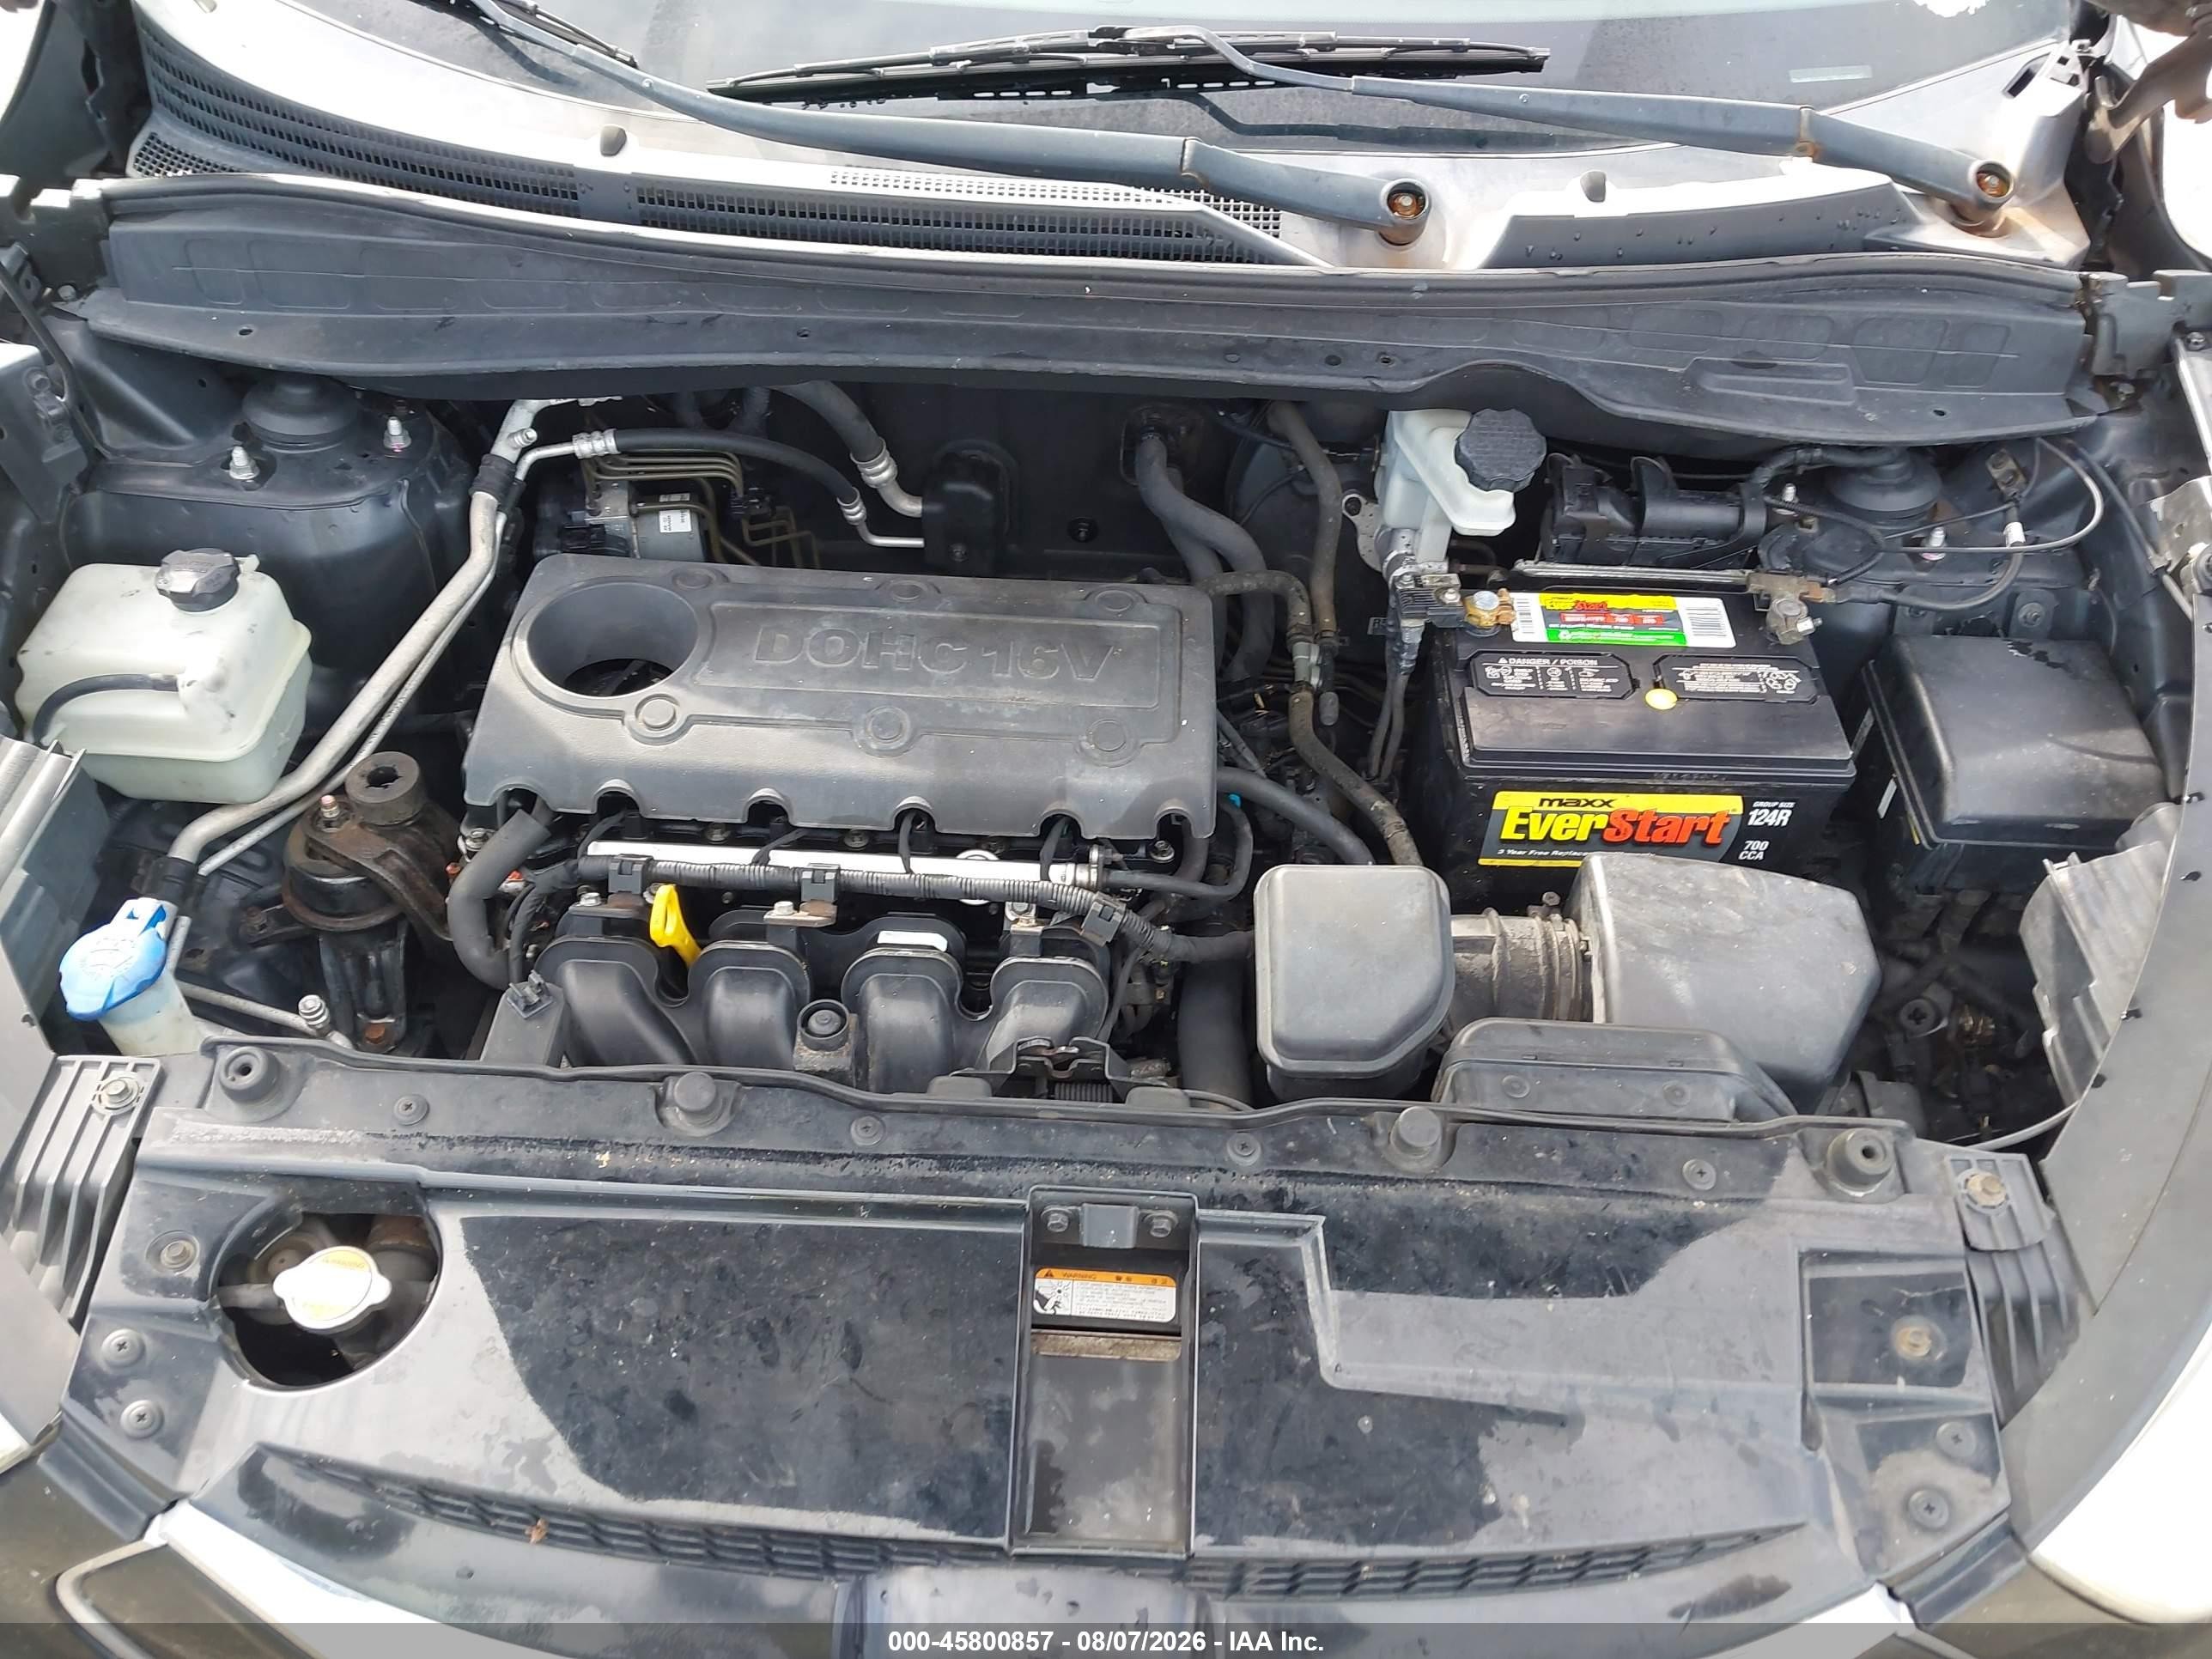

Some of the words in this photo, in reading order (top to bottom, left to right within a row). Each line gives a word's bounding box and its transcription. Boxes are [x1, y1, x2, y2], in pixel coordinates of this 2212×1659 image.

[753, 626, 969, 675] DOHC
[981, 640, 1115, 682] 16V
[1539, 798, 1616, 808] maxx
[1500, 805, 1731, 844] EverStart
[1747, 808, 1792, 827] 124R
[1743, 840, 1770, 851] 700
[1738, 850, 1765, 860] CCA
